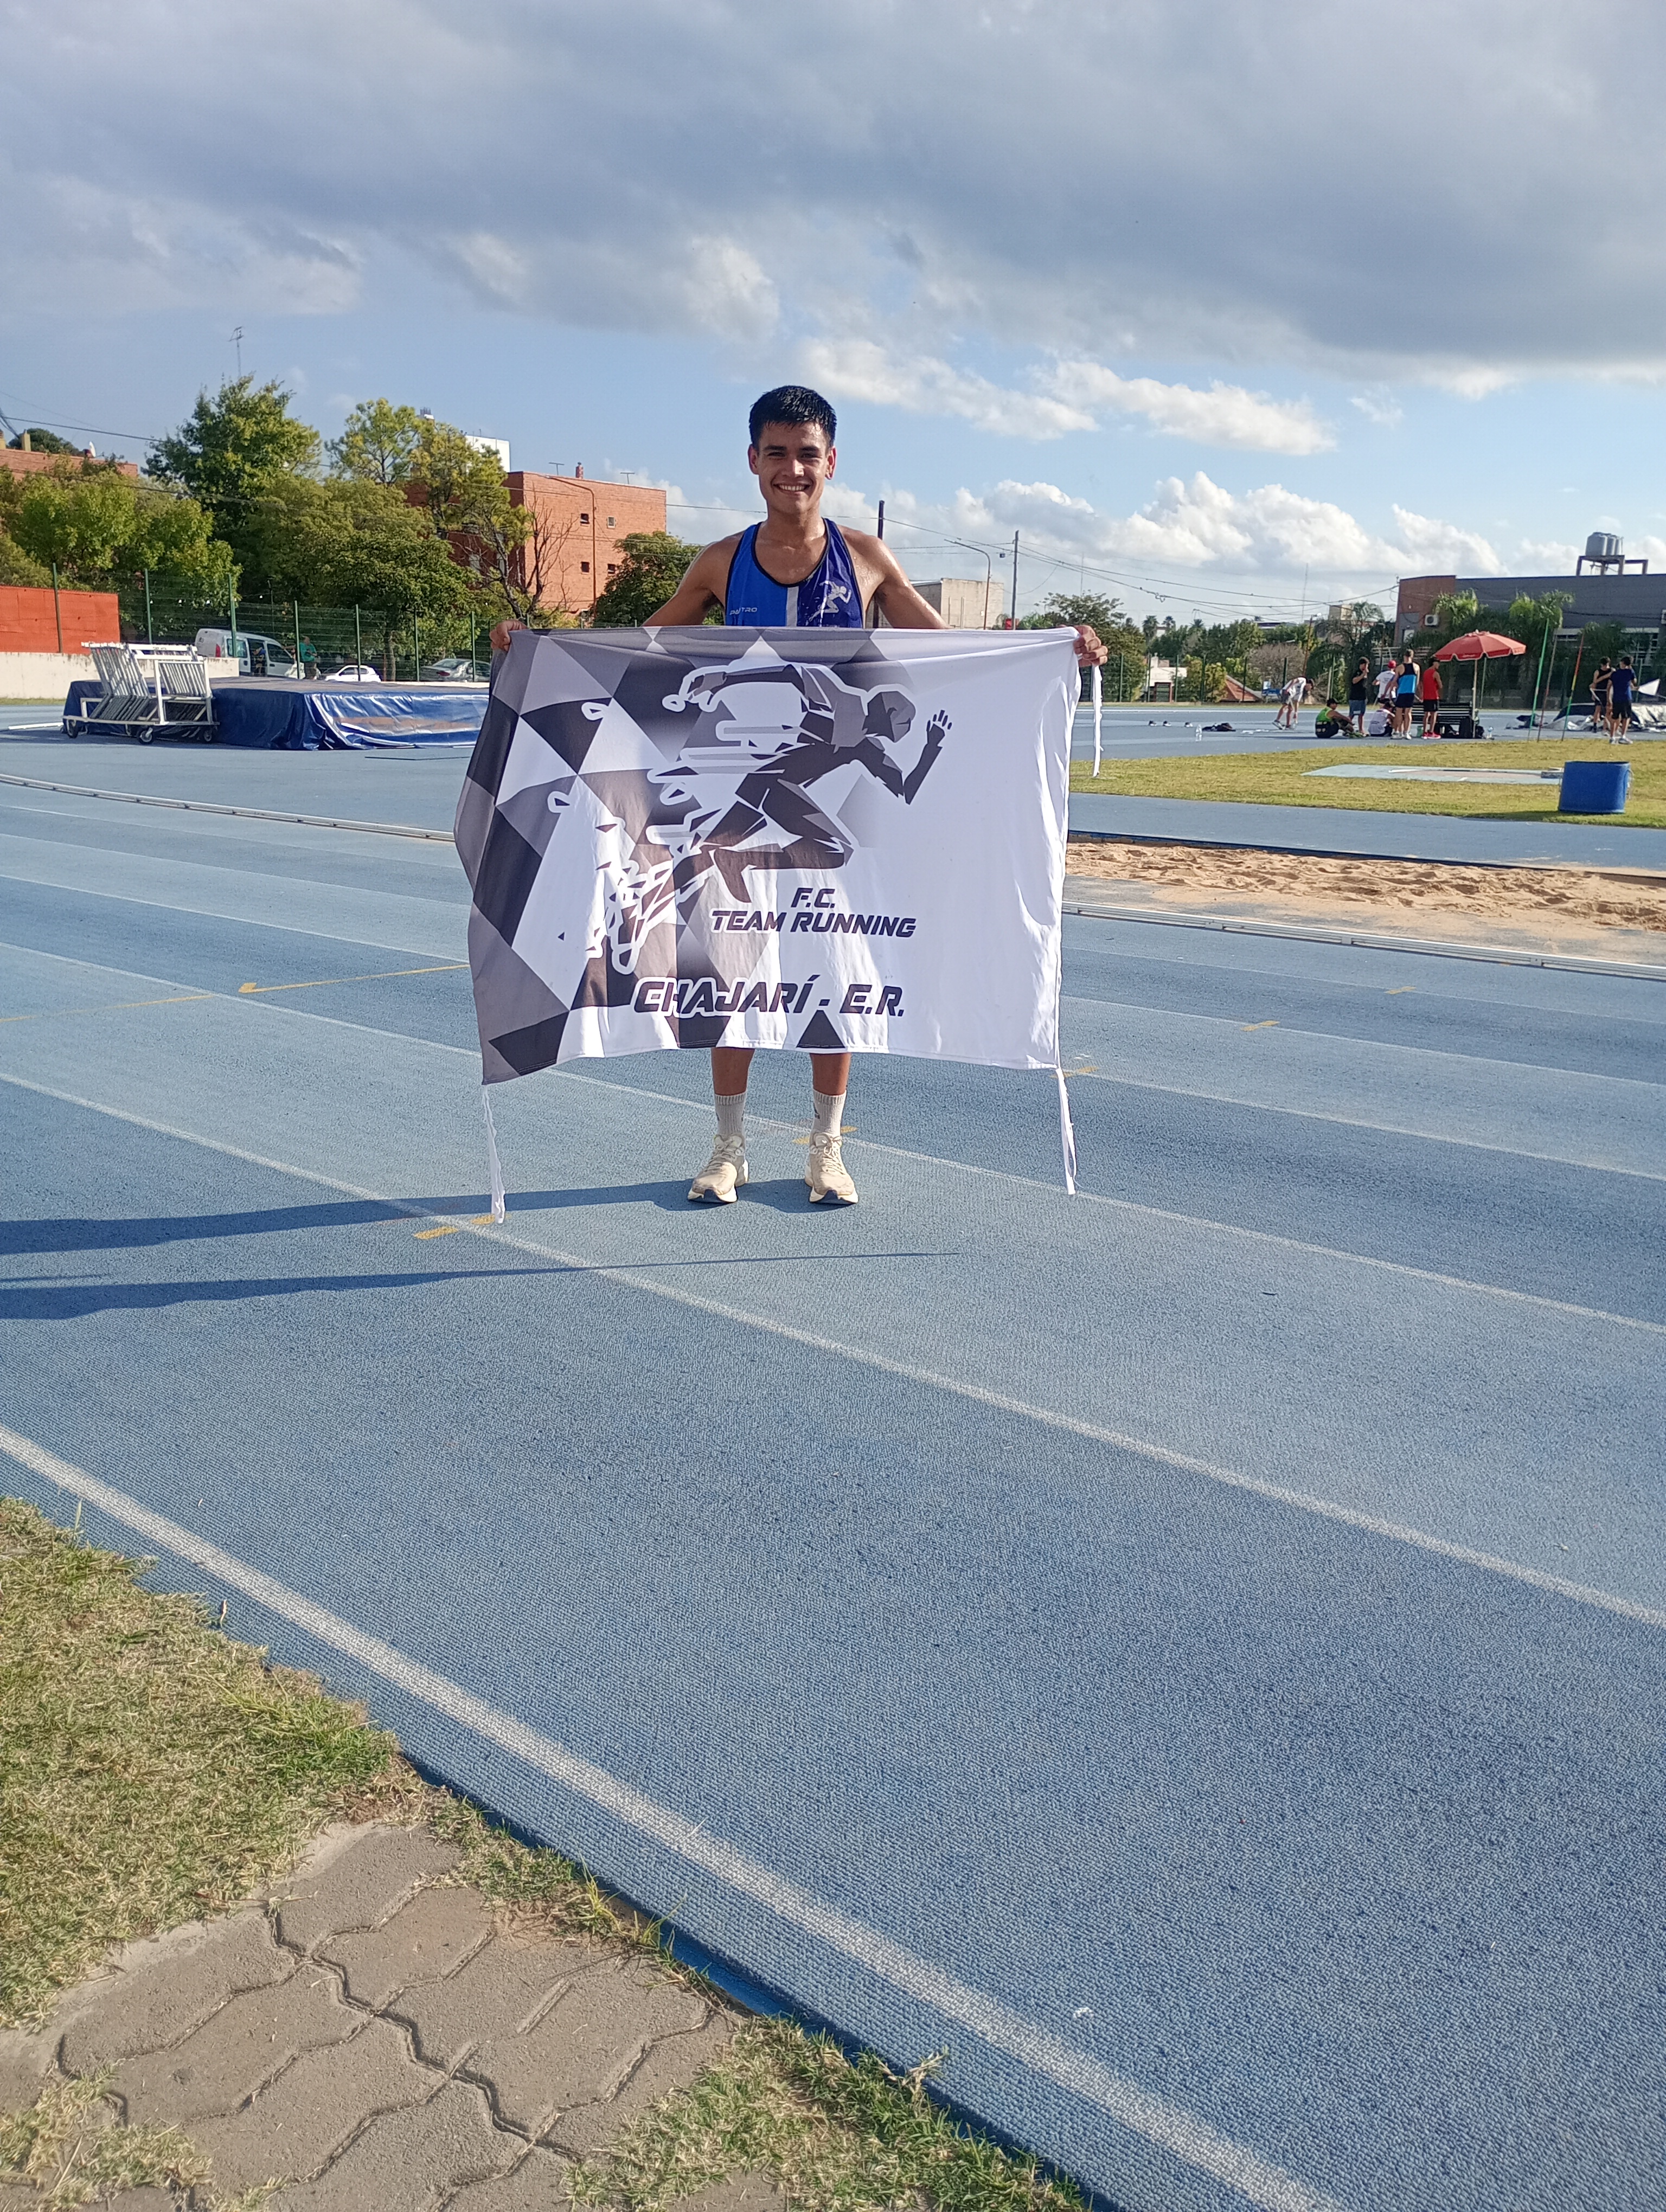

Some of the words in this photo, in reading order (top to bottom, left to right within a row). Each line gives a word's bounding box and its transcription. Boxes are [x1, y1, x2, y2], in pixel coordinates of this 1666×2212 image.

[791, 888, 836, 908] F.C.
[712, 911, 787, 931] TEAM
[790, 912, 917, 938] RUNNING
[634, 974, 821, 1014] CHAJARÍ
[840, 984, 904, 1017] E.R.
